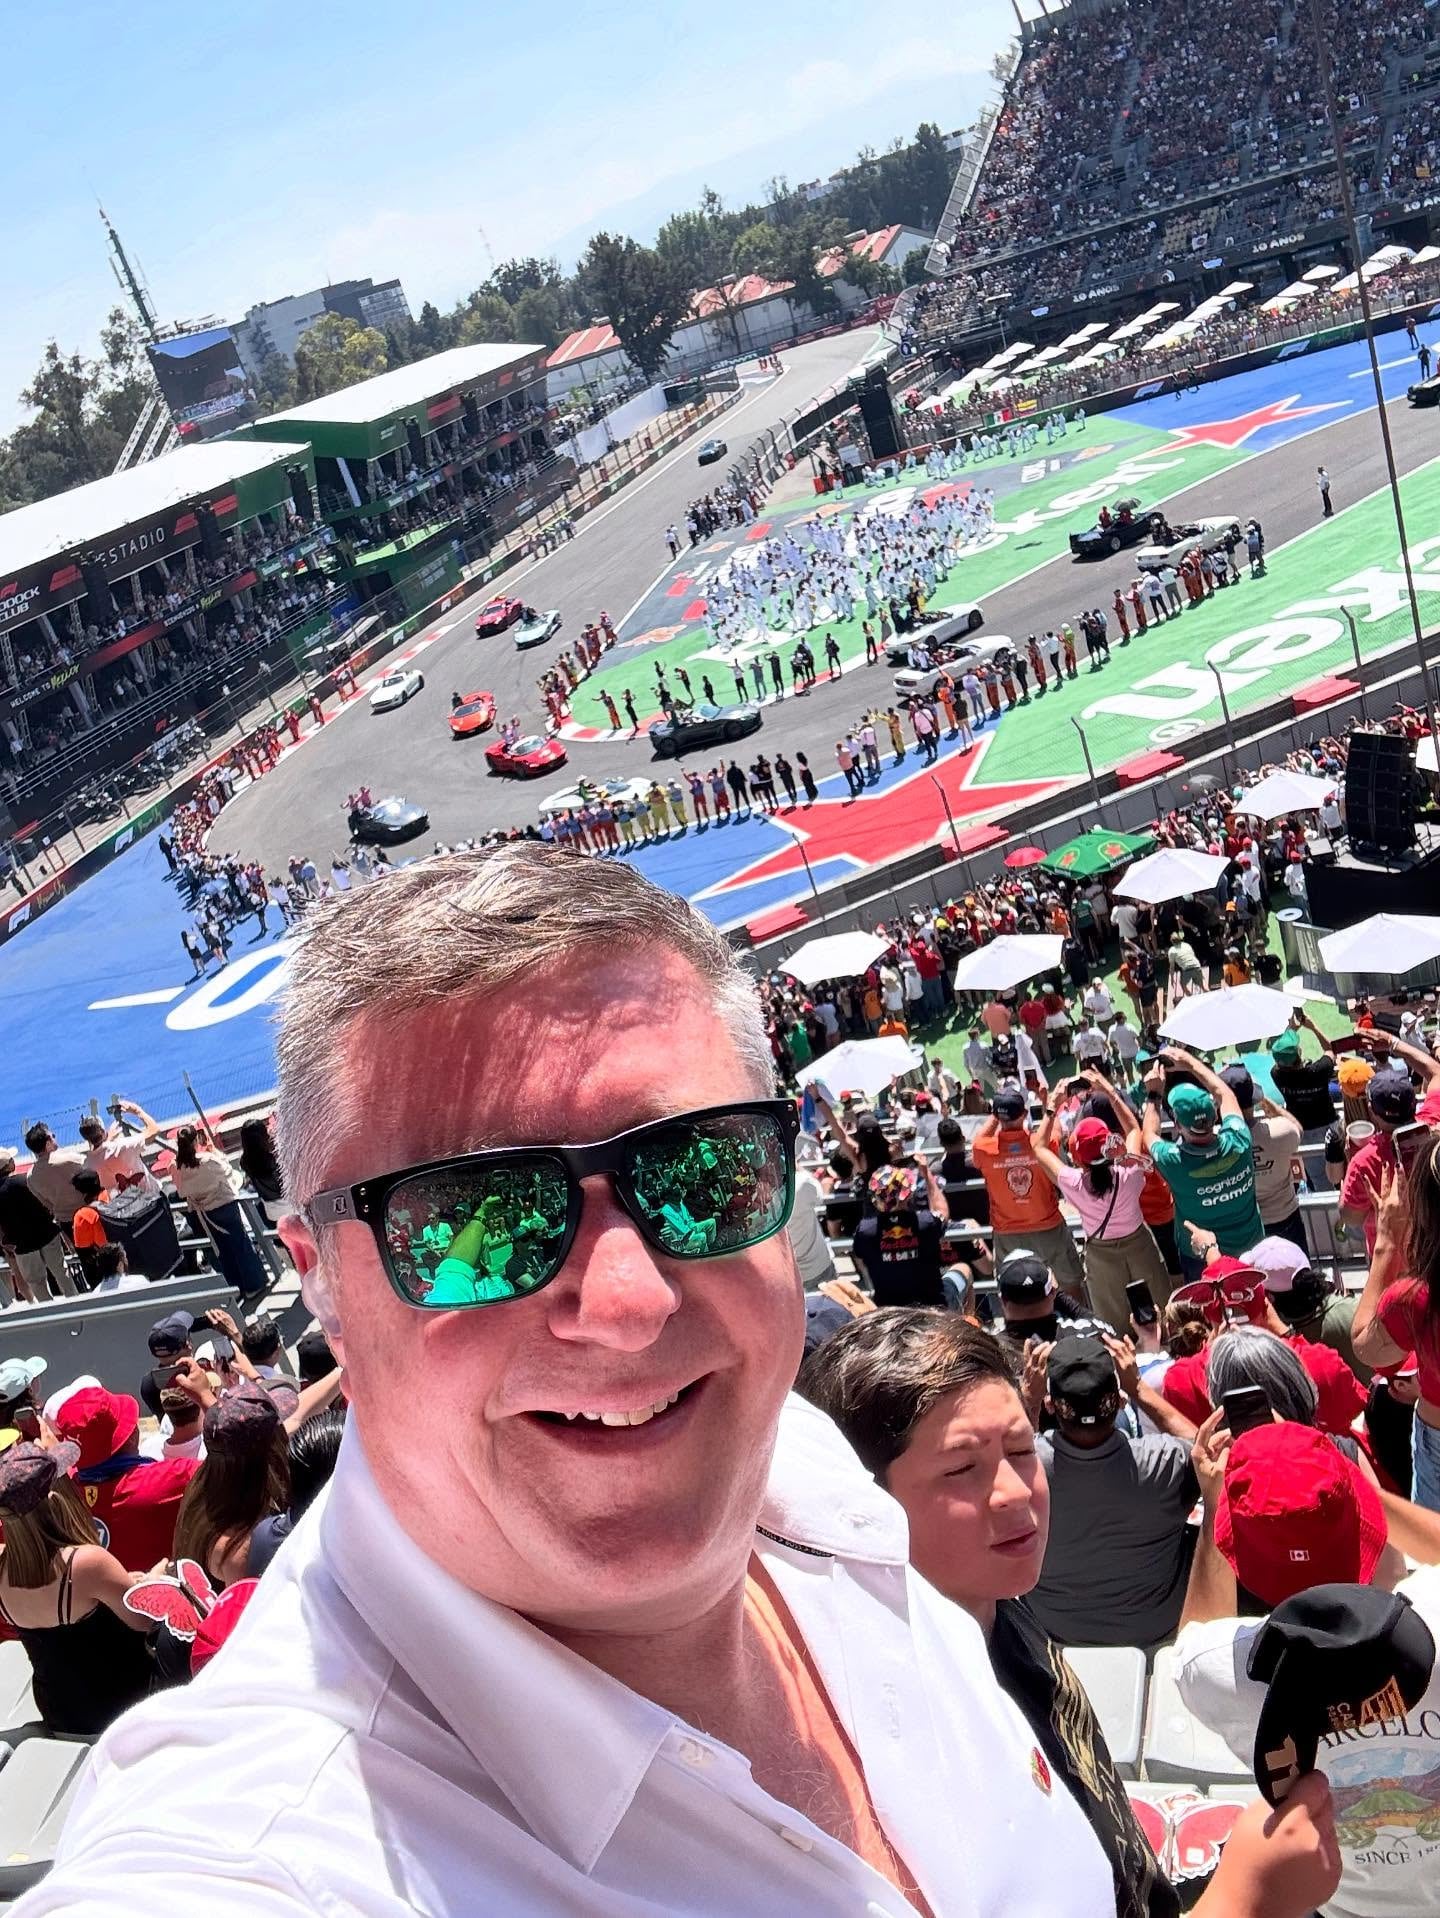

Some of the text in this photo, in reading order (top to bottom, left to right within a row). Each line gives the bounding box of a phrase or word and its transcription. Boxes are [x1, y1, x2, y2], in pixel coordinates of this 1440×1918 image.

[9, 687, 41, 708] WELCOME
[1196, 1165, 1252, 1196] cognizant
[1354, 1850, 1412, 1866] SINCE
